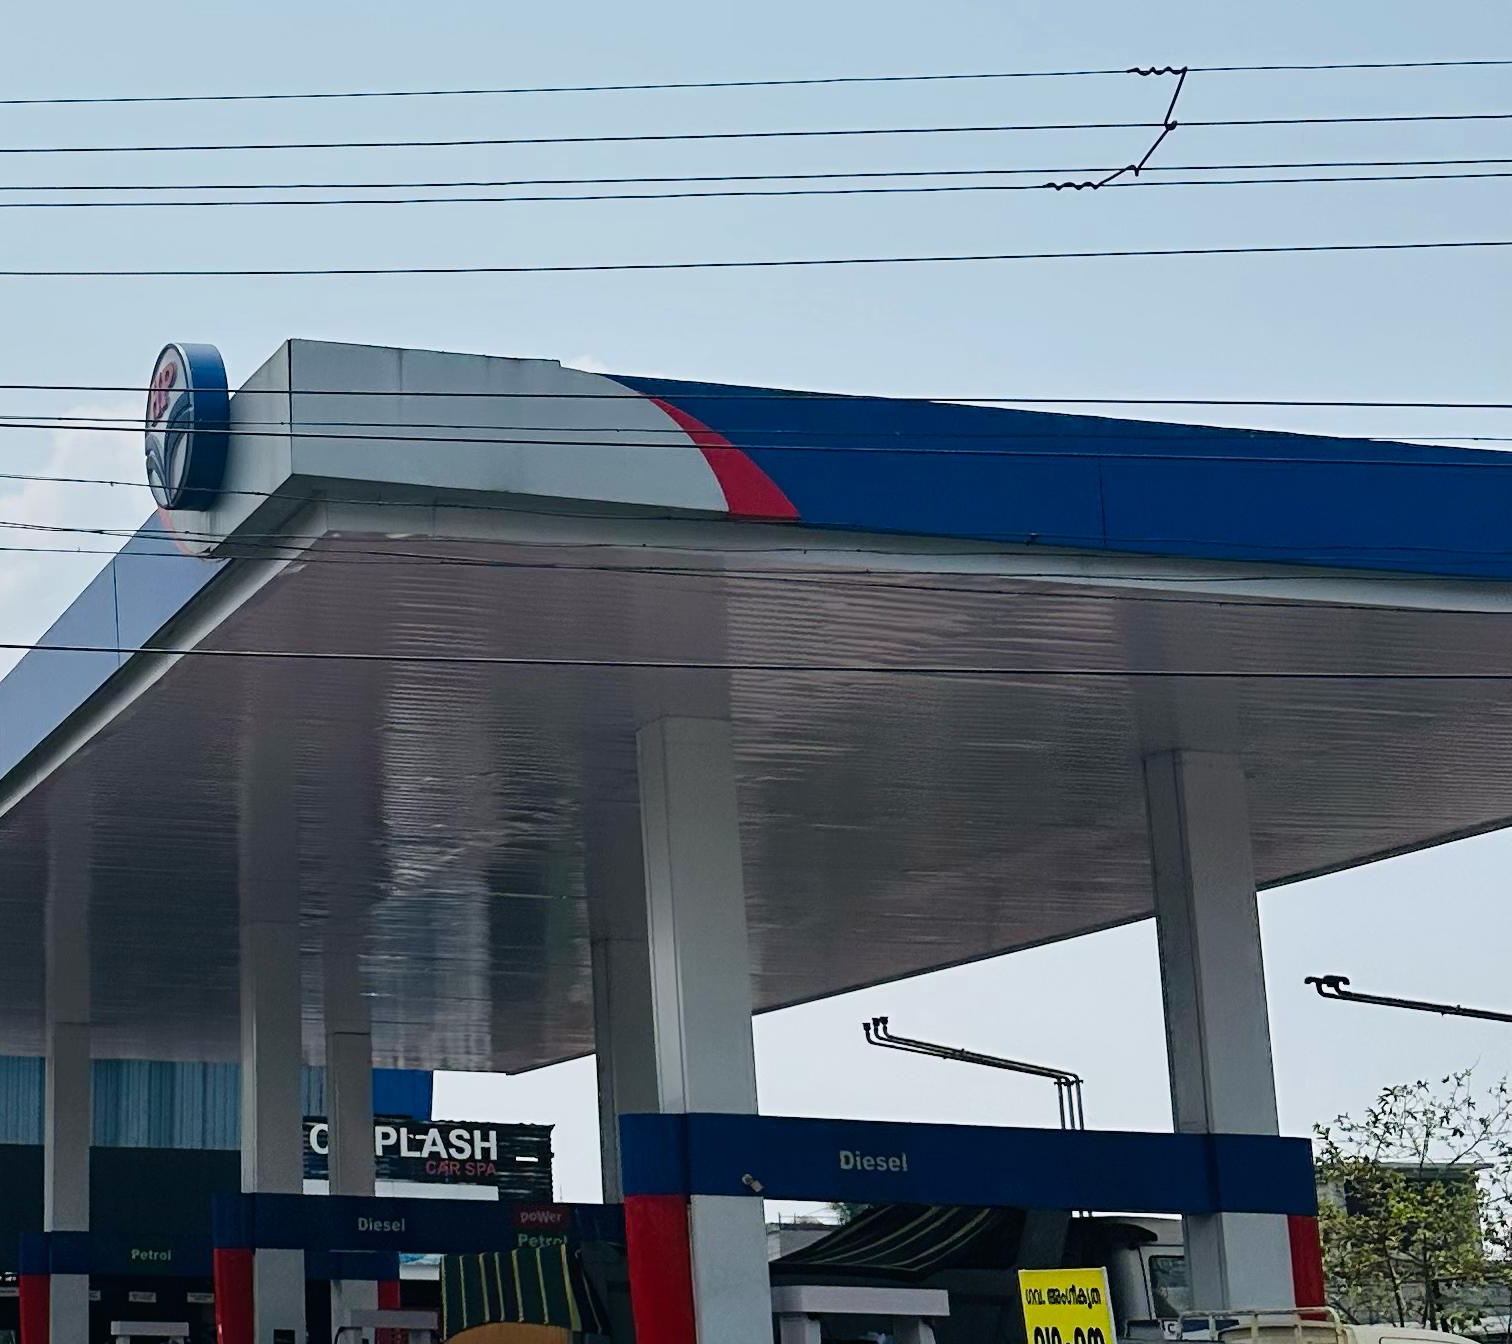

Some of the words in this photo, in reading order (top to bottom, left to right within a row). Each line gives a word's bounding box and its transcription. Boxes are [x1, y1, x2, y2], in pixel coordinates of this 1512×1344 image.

[375, 1126, 497, 1161] PLASH
[425, 1161, 460, 1175] CAR
[465, 1162, 497, 1176] SPA
[839, 1150, 908, 1172] Diesel
[358, 1216, 406, 1232] Diesel
[131, 1247, 172, 1262] Petrol
